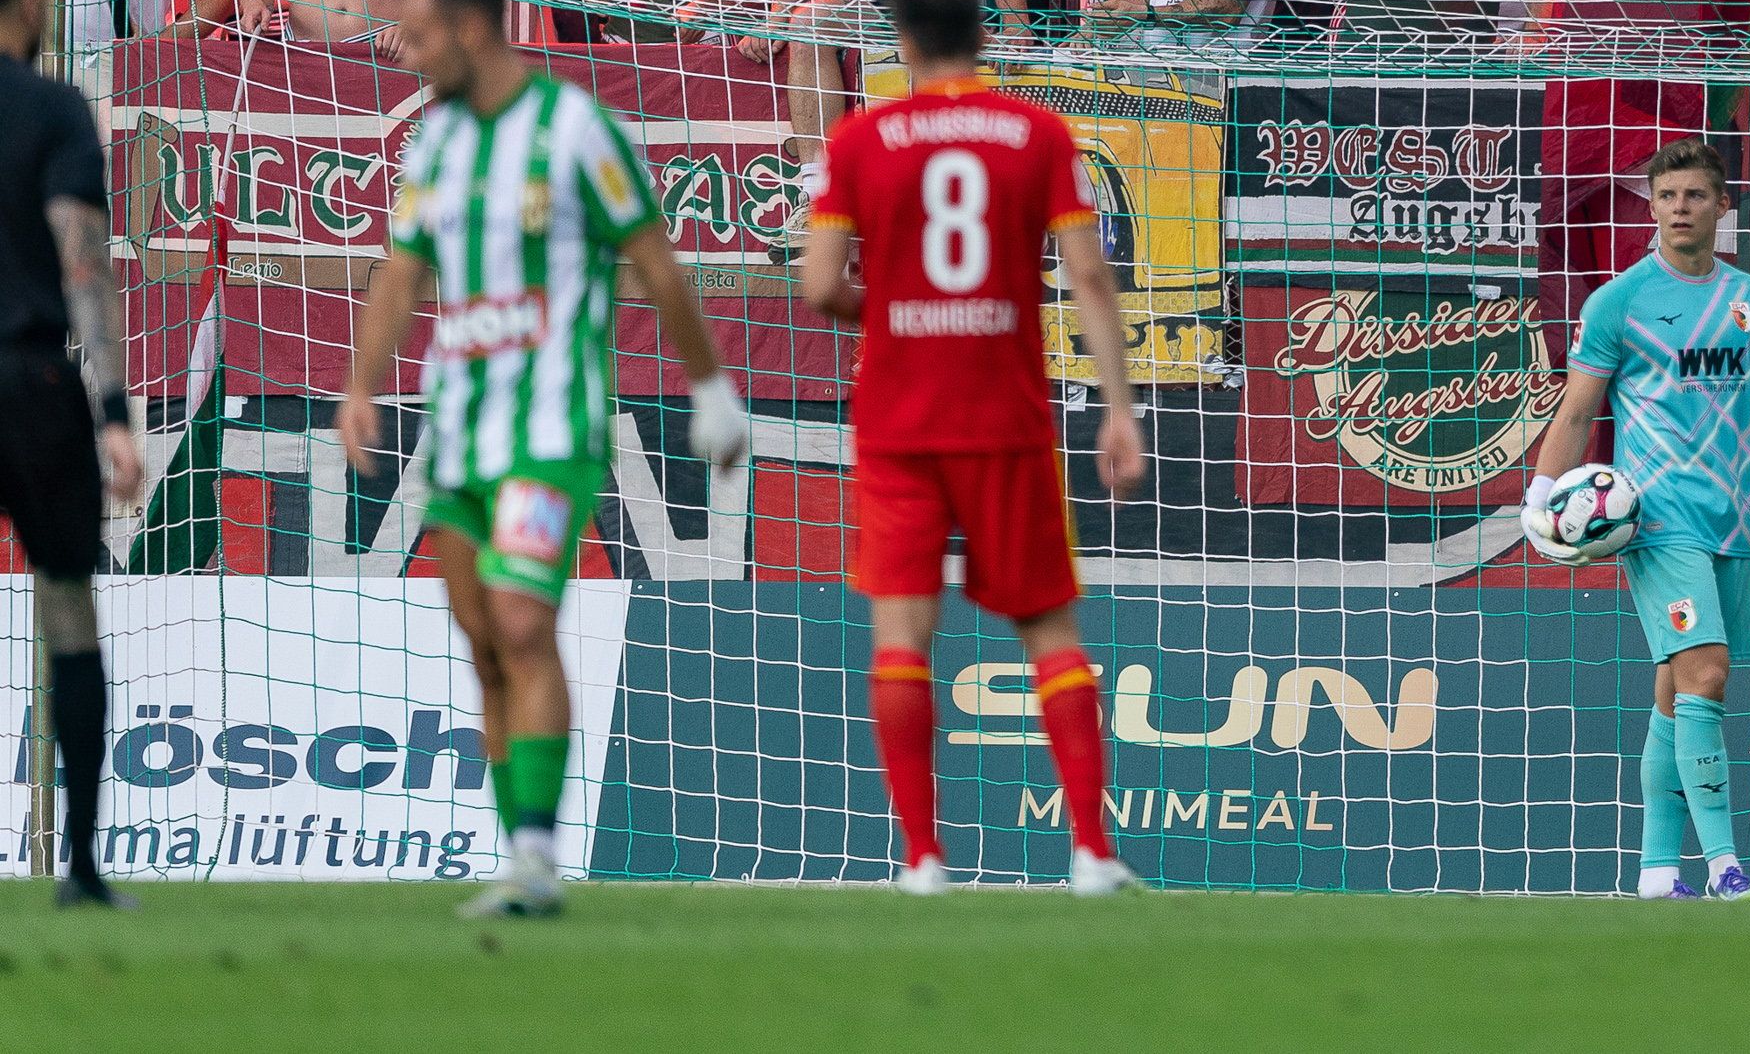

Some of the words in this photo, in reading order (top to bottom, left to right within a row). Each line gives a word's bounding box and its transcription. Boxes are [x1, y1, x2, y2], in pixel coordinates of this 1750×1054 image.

[1256, 119, 1514, 194] WEST
[920, 148, 993, 294] 8
[227, 255, 284, 282] Legio
[1678, 347, 1746, 378] WWK
[1370, 452, 1418, 487] ARE
[1424, 444, 1510, 488] UNITED
[947, 662, 1440, 750] SUN
[13, 702, 488, 792] ösch
[1696, 755, 1719, 767] FCA
[1017, 787, 1334, 832] MNIMEAL
[226, 812, 477, 879] lüftung
